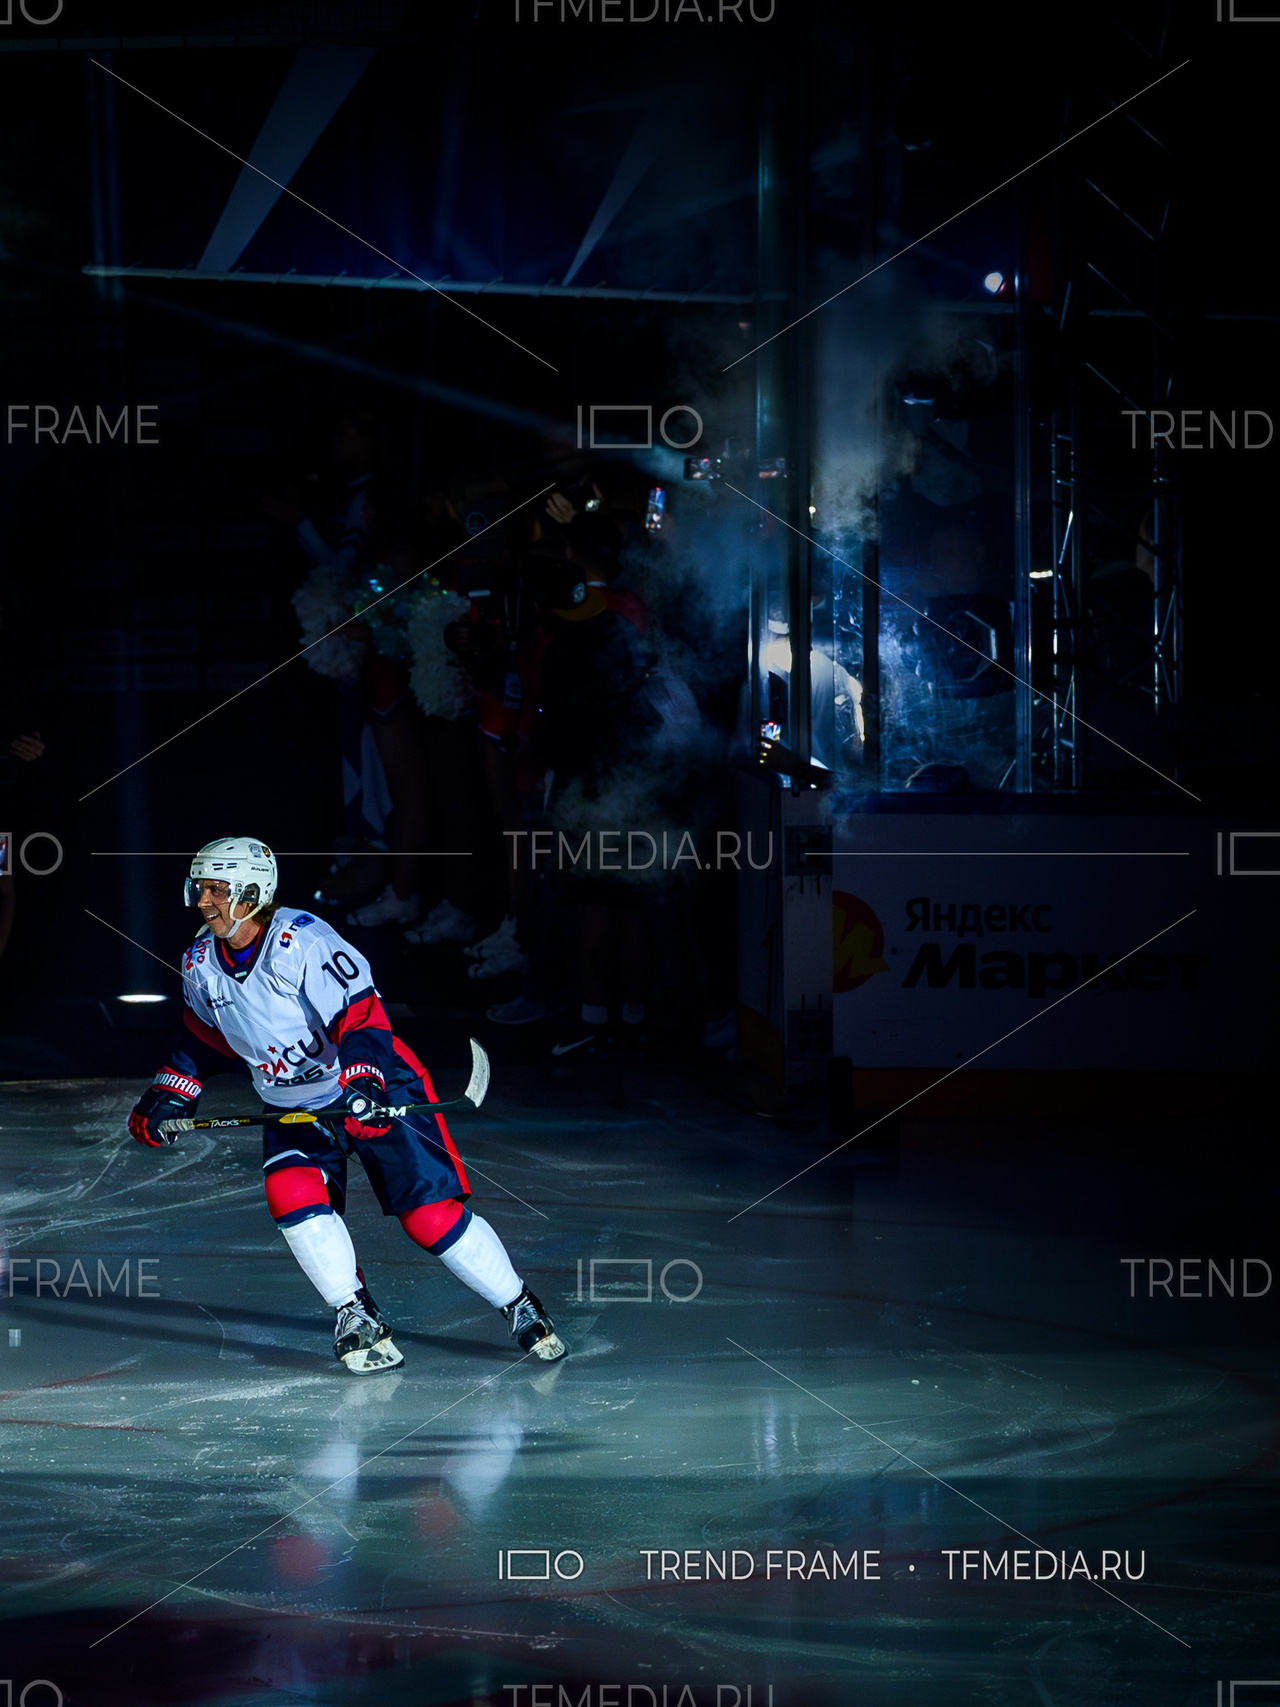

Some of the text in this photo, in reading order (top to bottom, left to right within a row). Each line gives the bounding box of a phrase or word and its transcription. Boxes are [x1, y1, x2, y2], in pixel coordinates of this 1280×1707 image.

[905, 897, 1052, 937] Яндекс
[321, 950, 360, 990] 10
[901, 943, 1212, 998] Маркет
